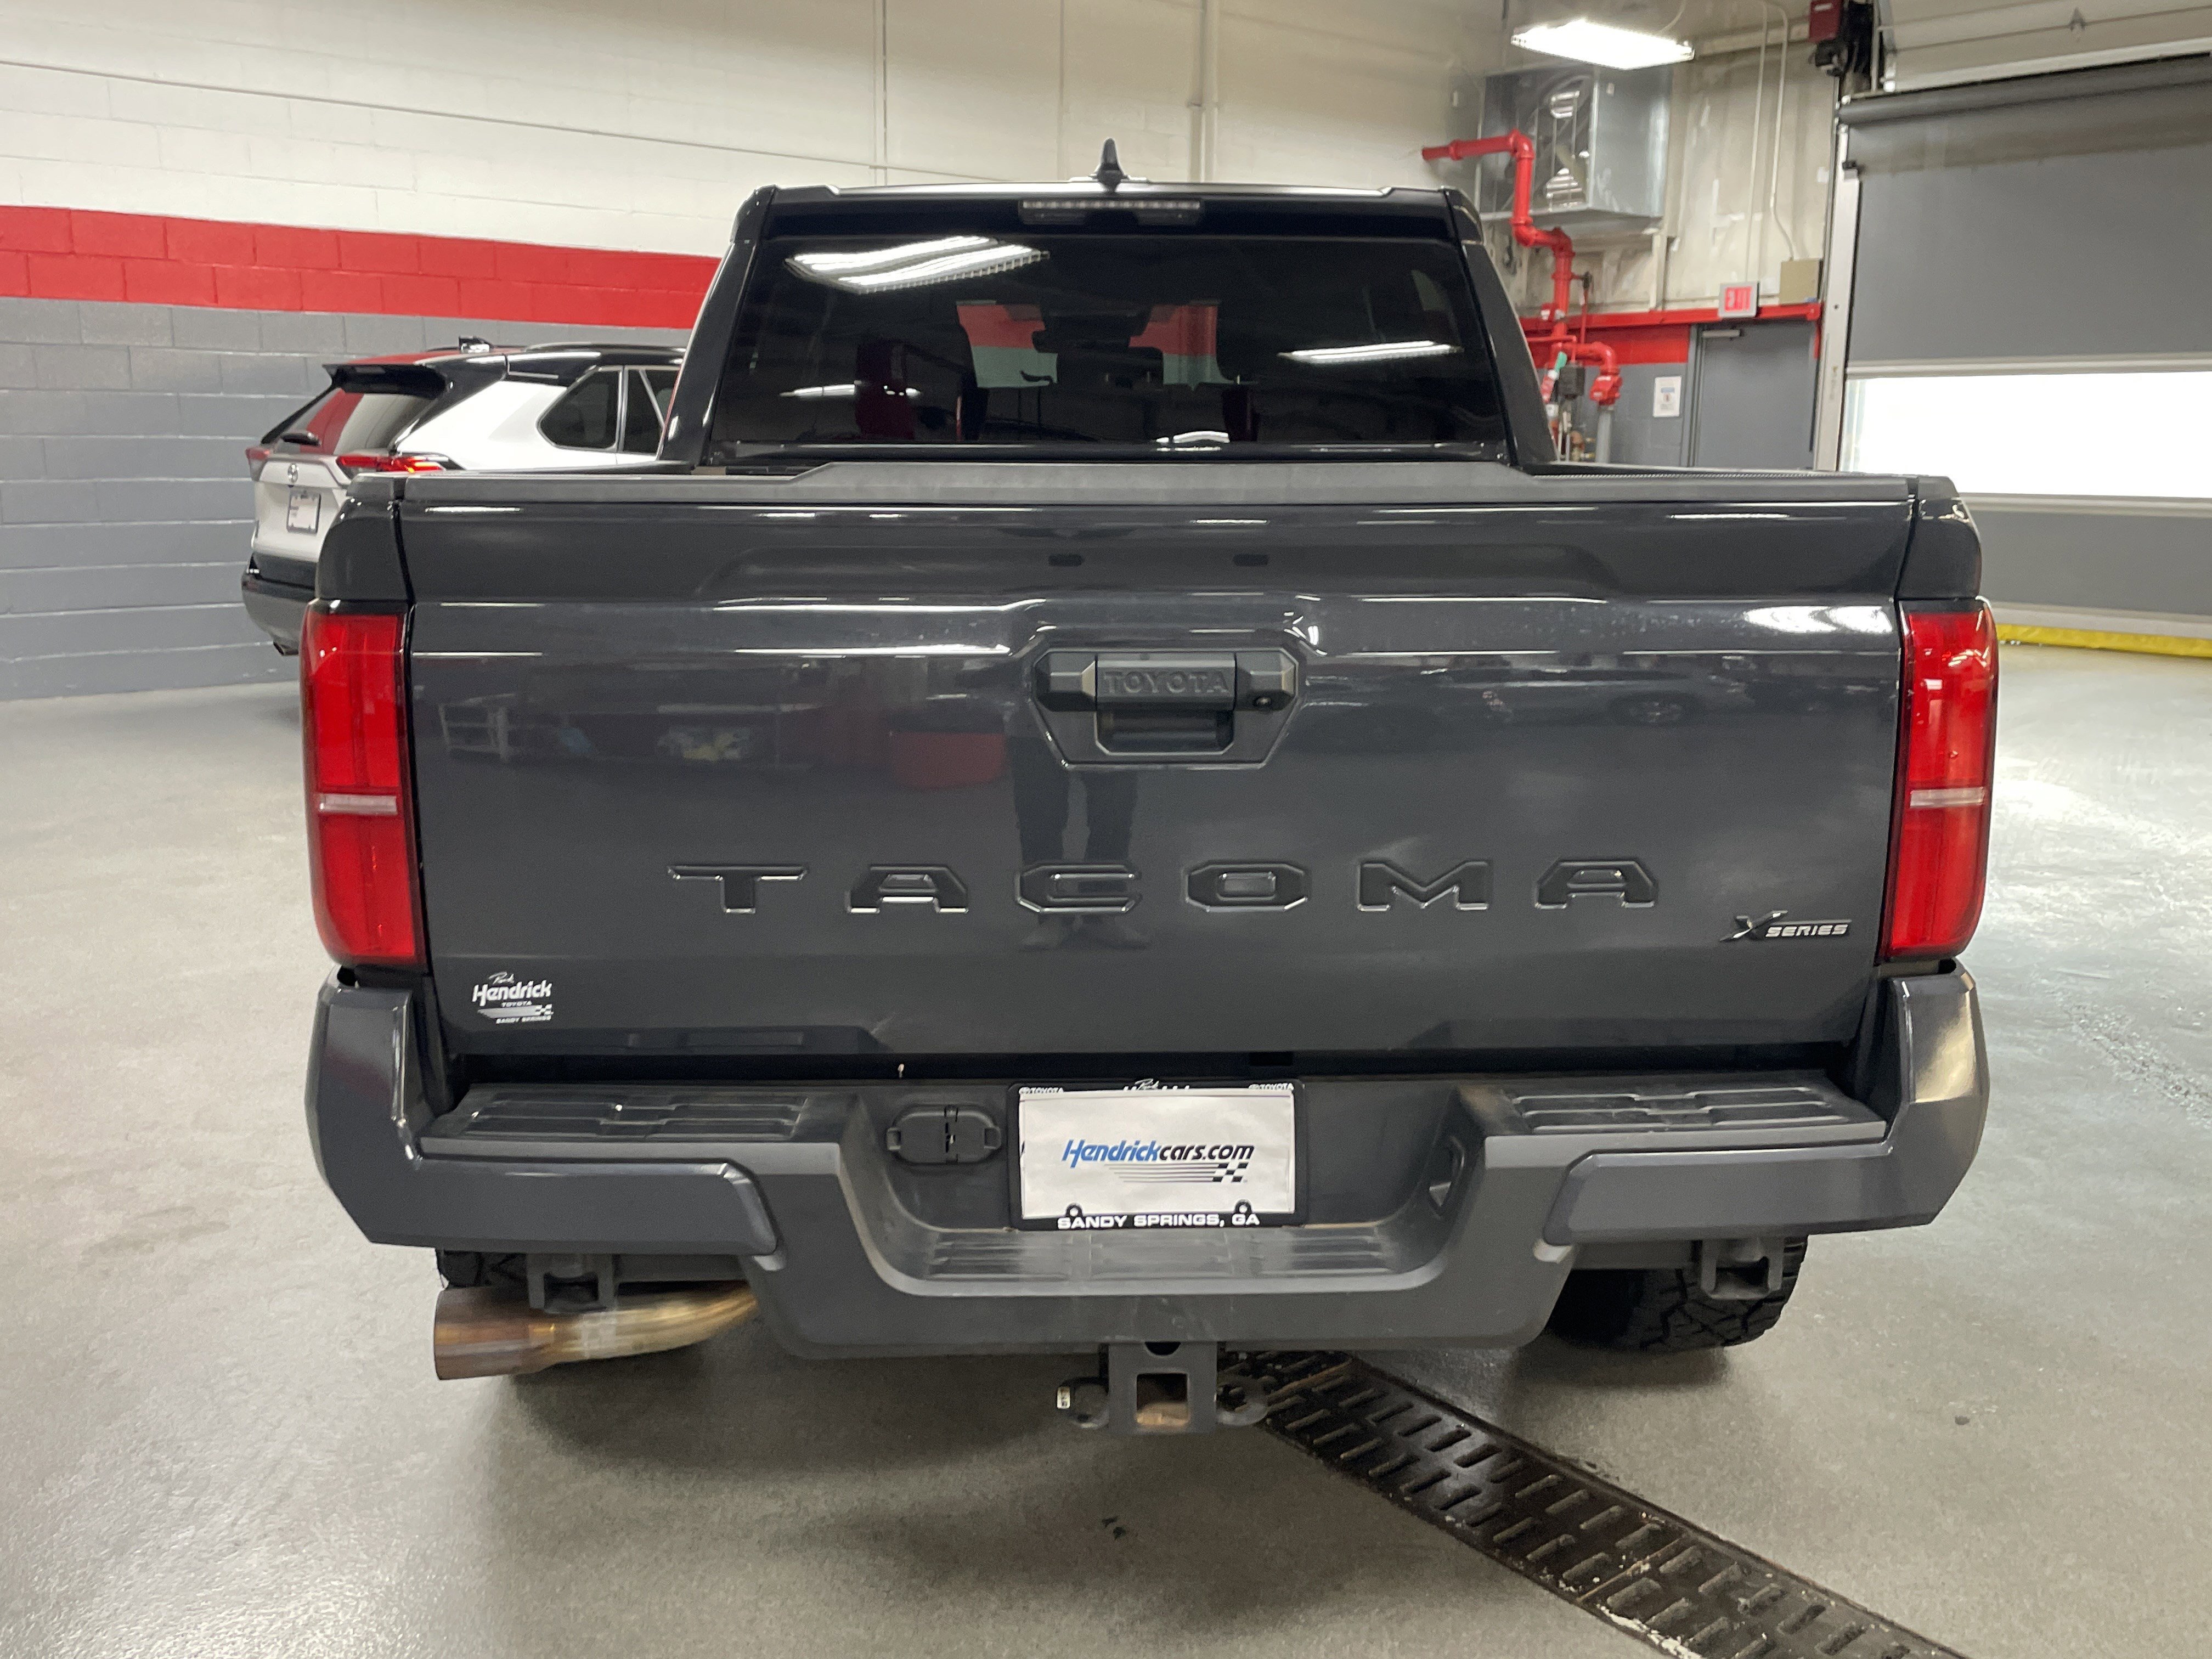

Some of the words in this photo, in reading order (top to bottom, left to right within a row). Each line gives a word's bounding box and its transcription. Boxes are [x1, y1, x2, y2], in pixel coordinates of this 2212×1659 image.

[1725, 286, 1753, 312] EXIT
[1103, 671, 1228, 694] TOYOTA
[667, 859, 1659, 915] TACOMA
[1765, 924, 1849, 938] SERIES
[472, 980, 552, 1007] Hendrick
[1062, 1139, 1255, 1169] Hendrickcars.com
[1057, 1214, 1128, 1229] SANDY
[1134, 1213, 1224, 1227] SPRINGS,
[1232, 1212, 1261, 1226] GA
